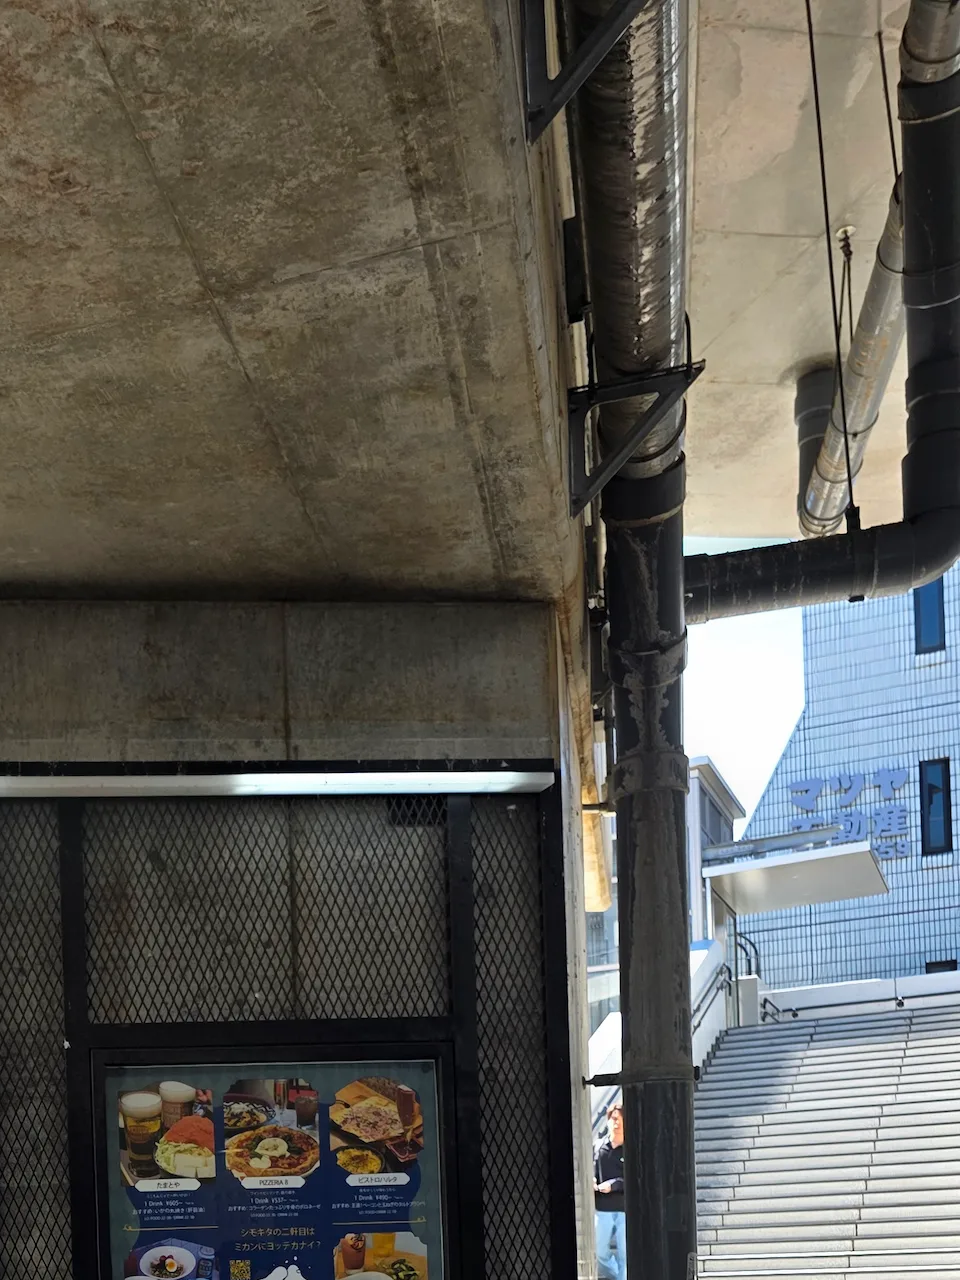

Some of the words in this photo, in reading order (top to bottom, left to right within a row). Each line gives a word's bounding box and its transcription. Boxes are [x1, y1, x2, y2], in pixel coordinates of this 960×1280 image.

[788, 768, 909, 811] マツヤ
[240, 1226, 316, 1237] シモキタの二軒目は
